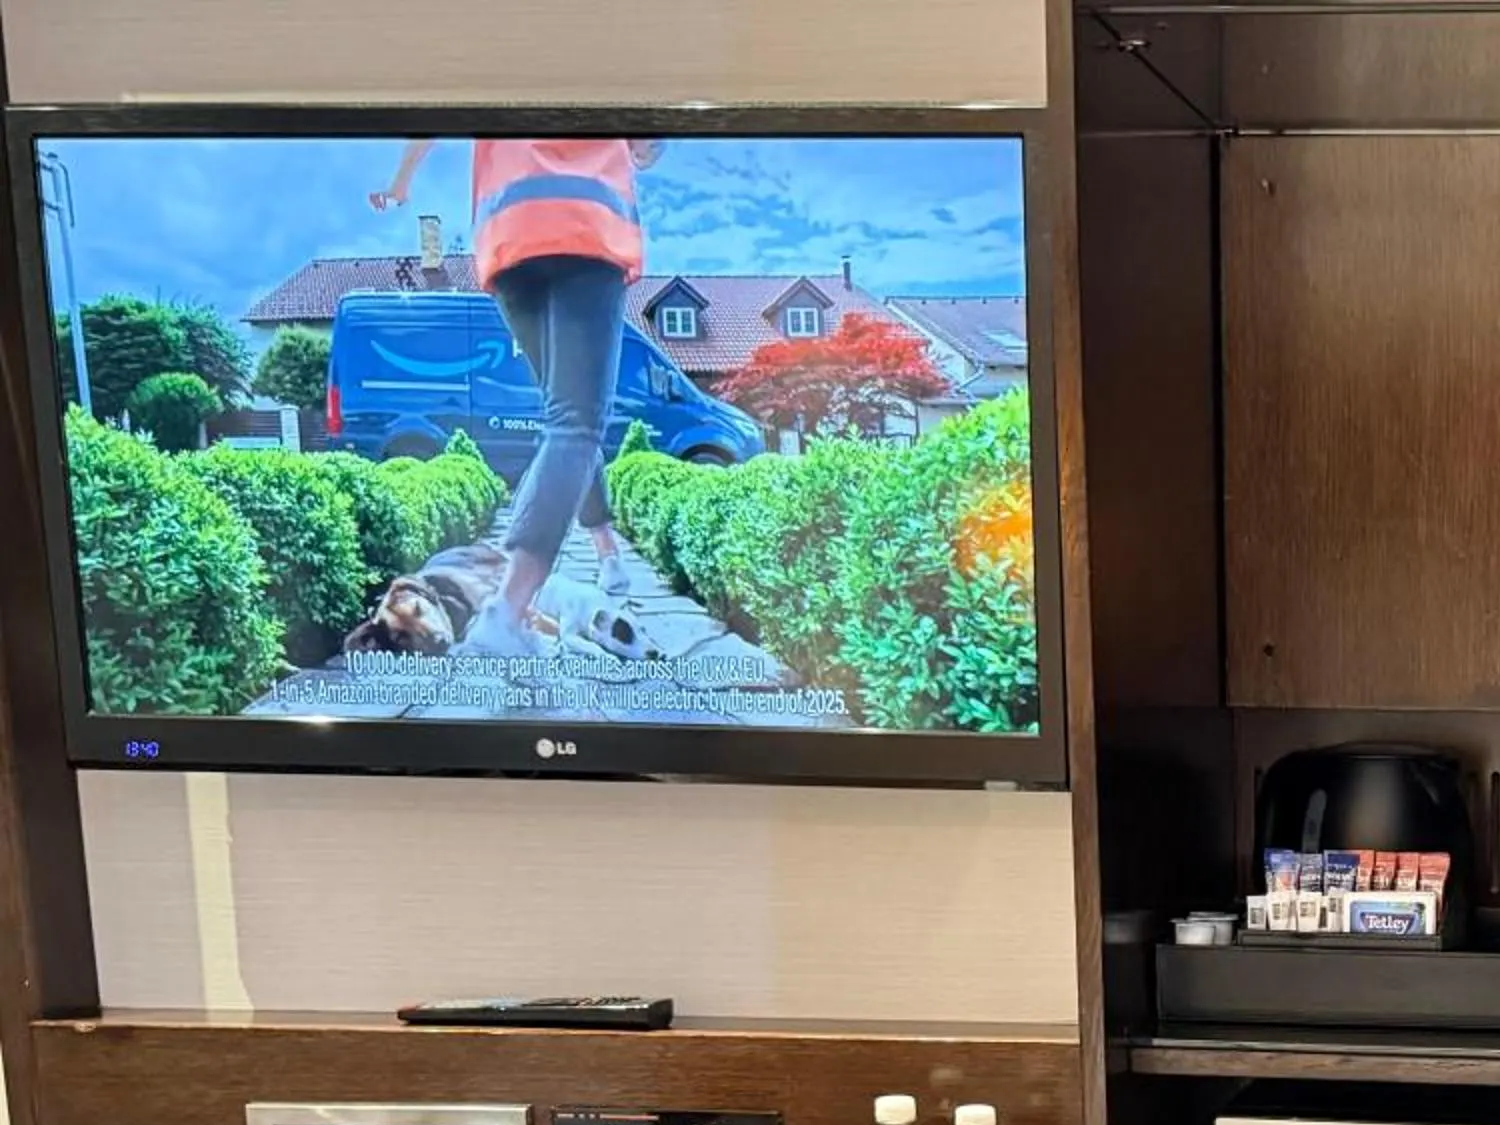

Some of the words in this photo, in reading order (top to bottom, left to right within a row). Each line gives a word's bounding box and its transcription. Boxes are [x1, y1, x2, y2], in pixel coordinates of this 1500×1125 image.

[399, 650, 452, 681] delivery
[455, 656, 506, 678] service
[510, 656, 564, 681] partner
[565, 656, 622, 679] vehicles
[626, 659, 673, 680] across
[676, 657, 701, 680] the
[703, 656, 728, 681] UK
[728, 656, 741, 681] &
[440, 682, 498, 713] delivery
[498, 685, 534, 707] vans
[535, 685, 549, 708] in
[552, 684, 575, 707] the
[576, 685, 600, 707] UK
[602, 685, 631, 709] will
[631, 685, 650, 710] be
[653, 685, 706, 711] electric
[709, 687, 725, 715] by
[727, 687, 753, 713] the
[756, 689, 785, 714] end
[788, 688, 804, 714] of
[806, 689, 850, 716] 2025.
[557, 740, 577, 755] LG
[1365, 914, 1410, 935] Tetley
